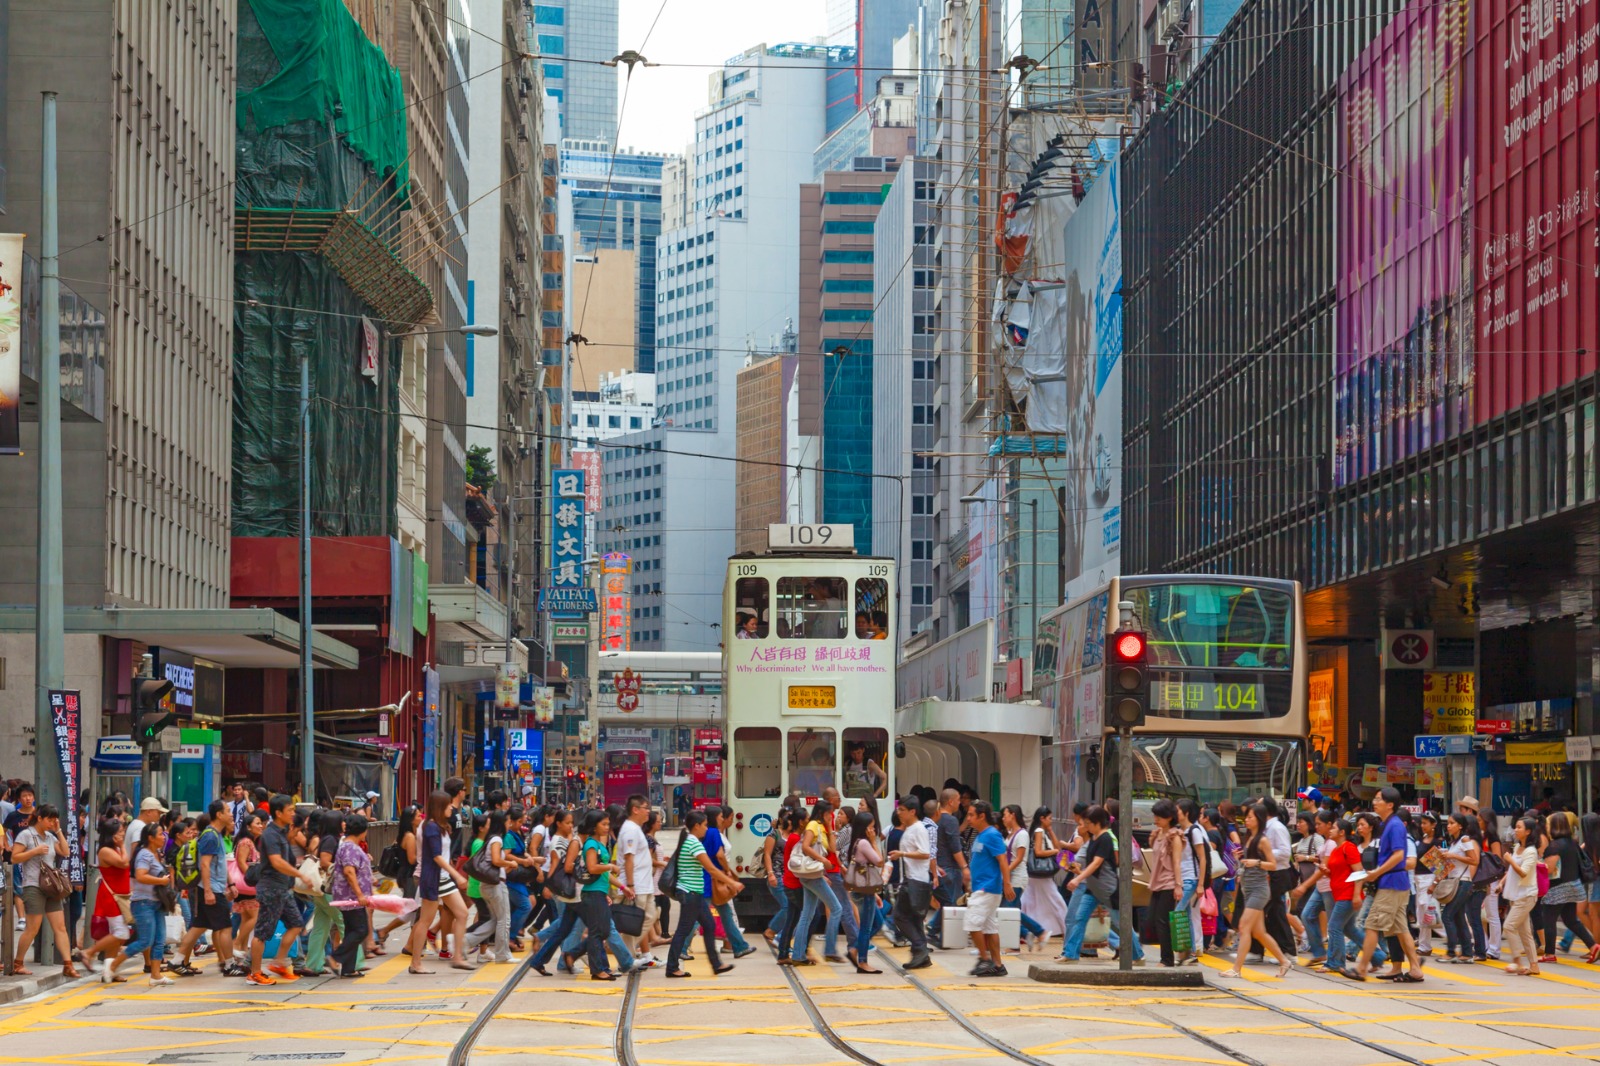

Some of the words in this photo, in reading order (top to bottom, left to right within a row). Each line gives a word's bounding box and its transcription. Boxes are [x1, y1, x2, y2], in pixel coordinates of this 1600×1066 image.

[1533, 52, 1565, 90] Wlcomes
[1554, 77, 1574, 110] Bnds
[555, 474, 583, 585] 日發文具
[790, 525, 833, 544] 109
[737, 564, 757, 576] 109
[869, 565, 888, 577] 109
[540, 601, 595, 610] STATIONERS
[750, 646, 807, 662] 人皆有母
[815, 646, 871, 662] 緣何歧視
[164, 662, 194, 690] SKECHERS
[736, 664, 752, 674] Why
[755, 664, 806, 673] discriminate?
[812, 664, 824, 672] We
[827, 664, 836, 672] all
[838, 664, 855, 672] have
[857, 664, 887, 673] mothers.
[1442, 673, 1475, 694] 手提
[1213, 683, 1258, 711] 104
[1447, 707, 1475, 717] Globe
